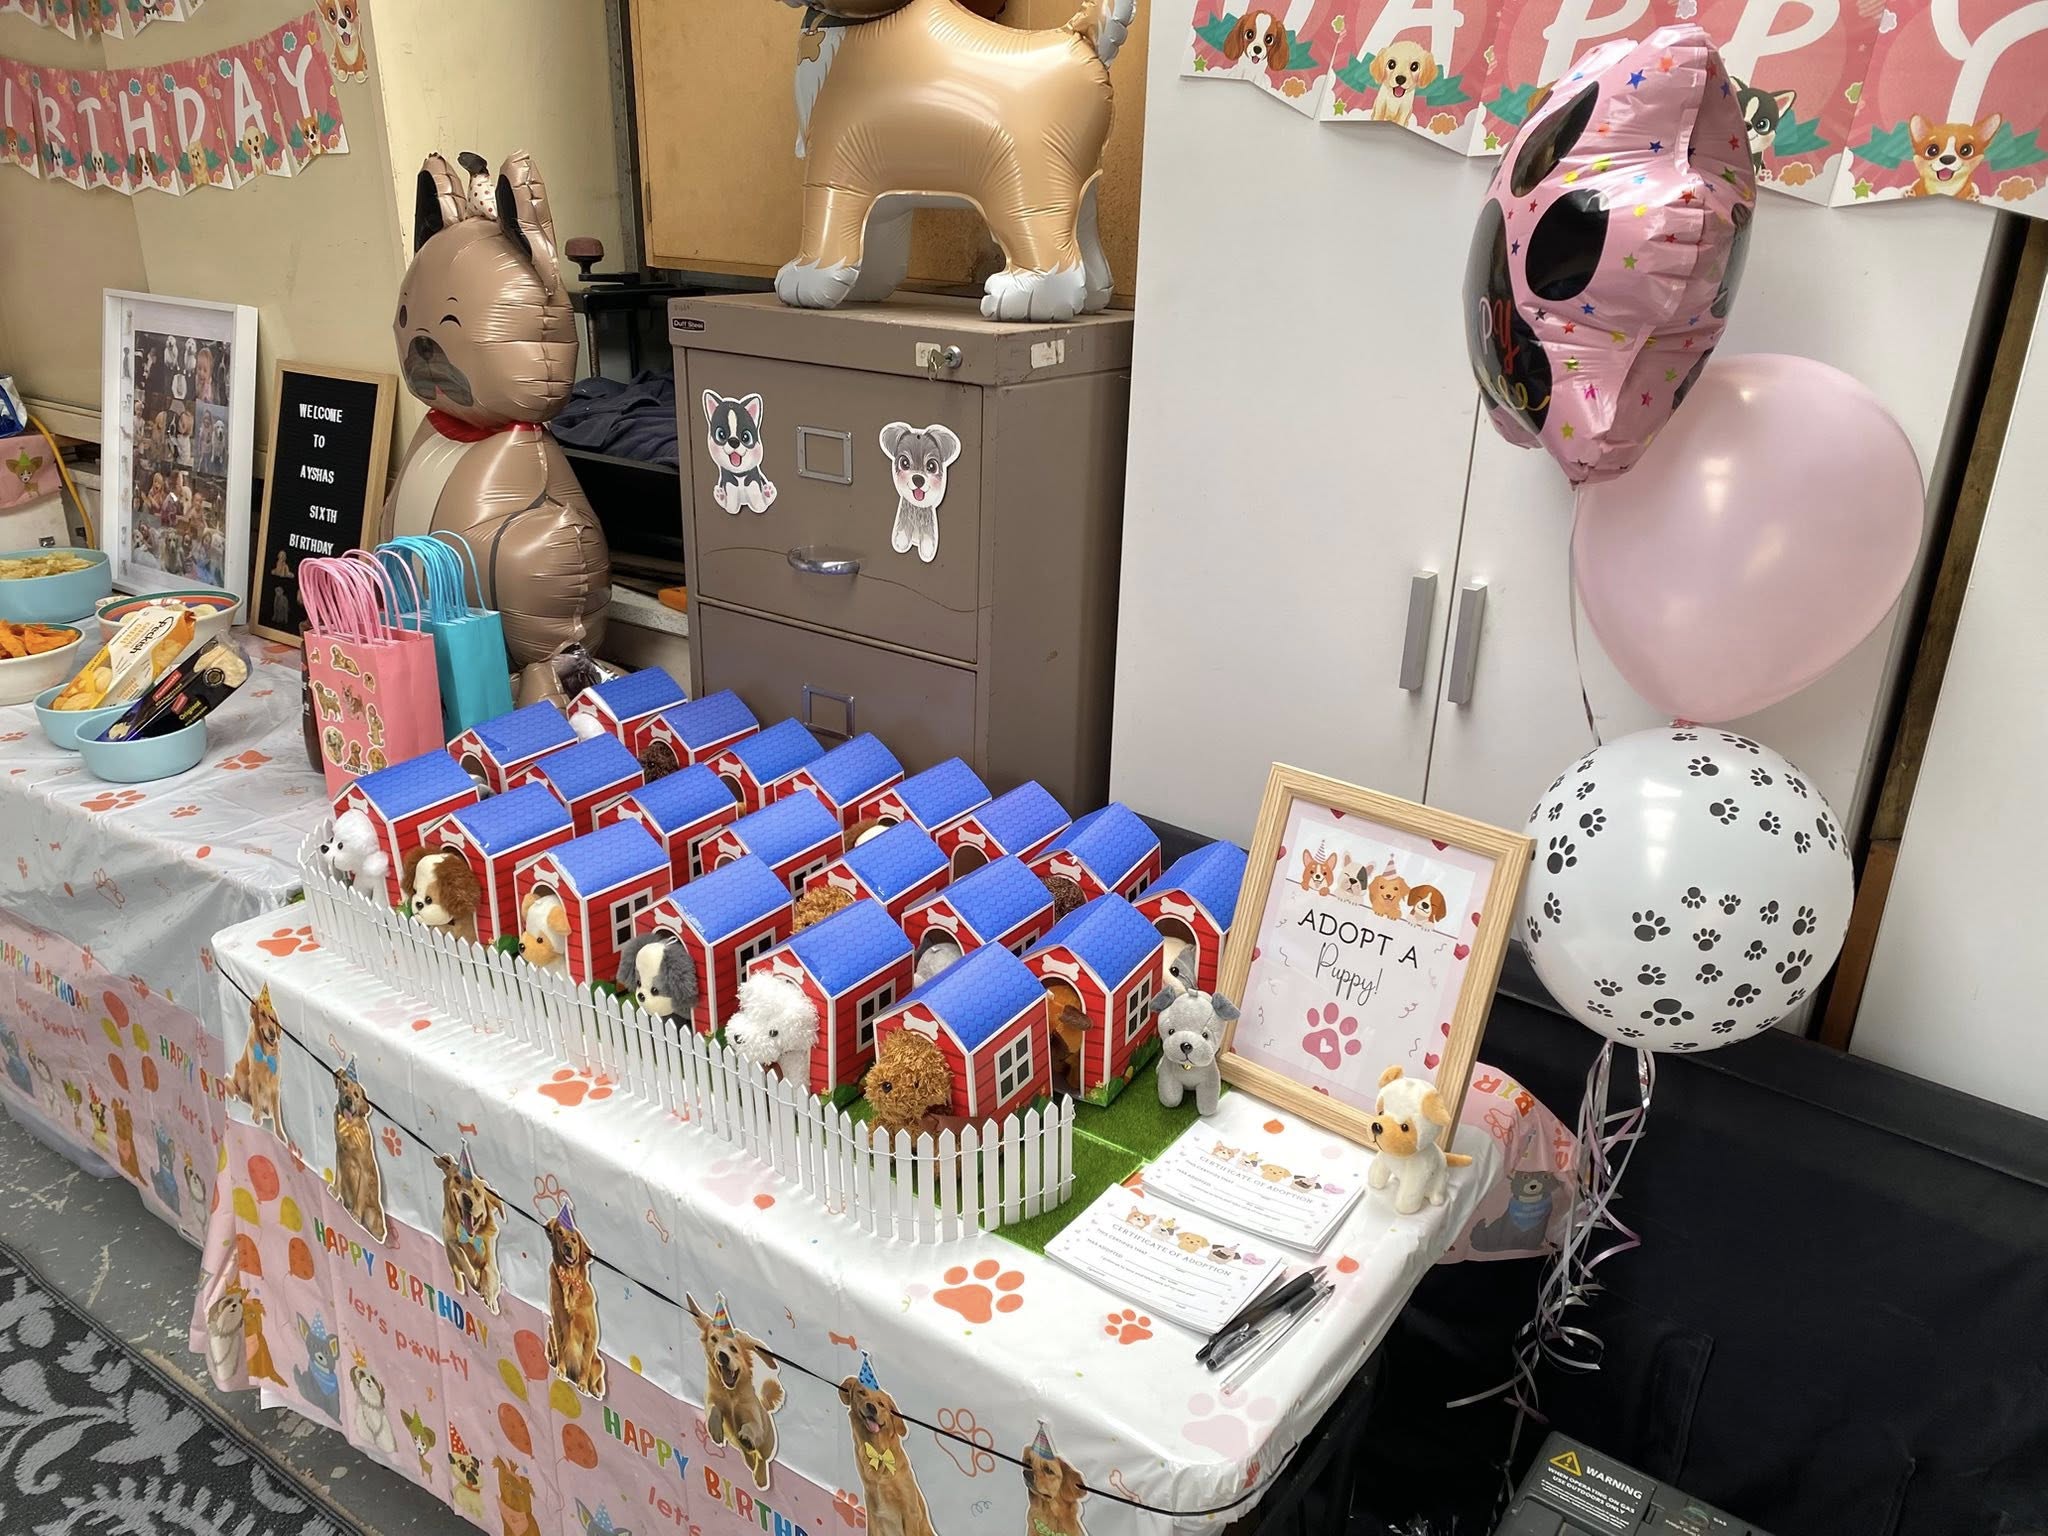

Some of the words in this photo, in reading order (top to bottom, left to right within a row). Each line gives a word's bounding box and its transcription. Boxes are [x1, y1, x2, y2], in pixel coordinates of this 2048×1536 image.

[299, 403, 343, 423] WELCOME
[313, 434, 325, 448] TO
[300, 464, 335, 484] AYSHAS
[309, 505, 337, 524] SIXTH
[289, 533, 334, 556] BIRTHDAY
[1297, 908, 1393, 956] ADOPT
[1398, 946, 1418, 969] A
[34, 961, 91, 1015] BIRTHDAY
[1315, 942, 1383, 1006] Puppy!
[159, 1034, 193, 1084] HAPPY
[1266, 1185, 1313, 1204] ADOPTION
[1112, 1223, 1169, 1252] CERTIFICATE
[1168, 1250, 1181, 1258] OF
[1182, 1256, 1232, 1277] ADOPTION
[314, 1217, 374, 1277] HAPPY
[384, 1260, 489, 1349] BIRTHDAY
[348, 1287, 388, 1335] let's
[602, 1405, 689, 1480] HAPPY
[1547, 1466, 1569, 1480] WHEN
[1568, 1477, 1608, 1500] OPERATING
[1608, 1497, 1620, 1506] ON
[1619, 1503, 1635, 1514] GAS
[1552, 1475, 1566, 1485] USE
[1566, 1482, 1605, 1505] OUTDOORS
[1605, 1502, 1626, 1514] ONLY
[1586, 1465, 1643, 1500] WARNING
